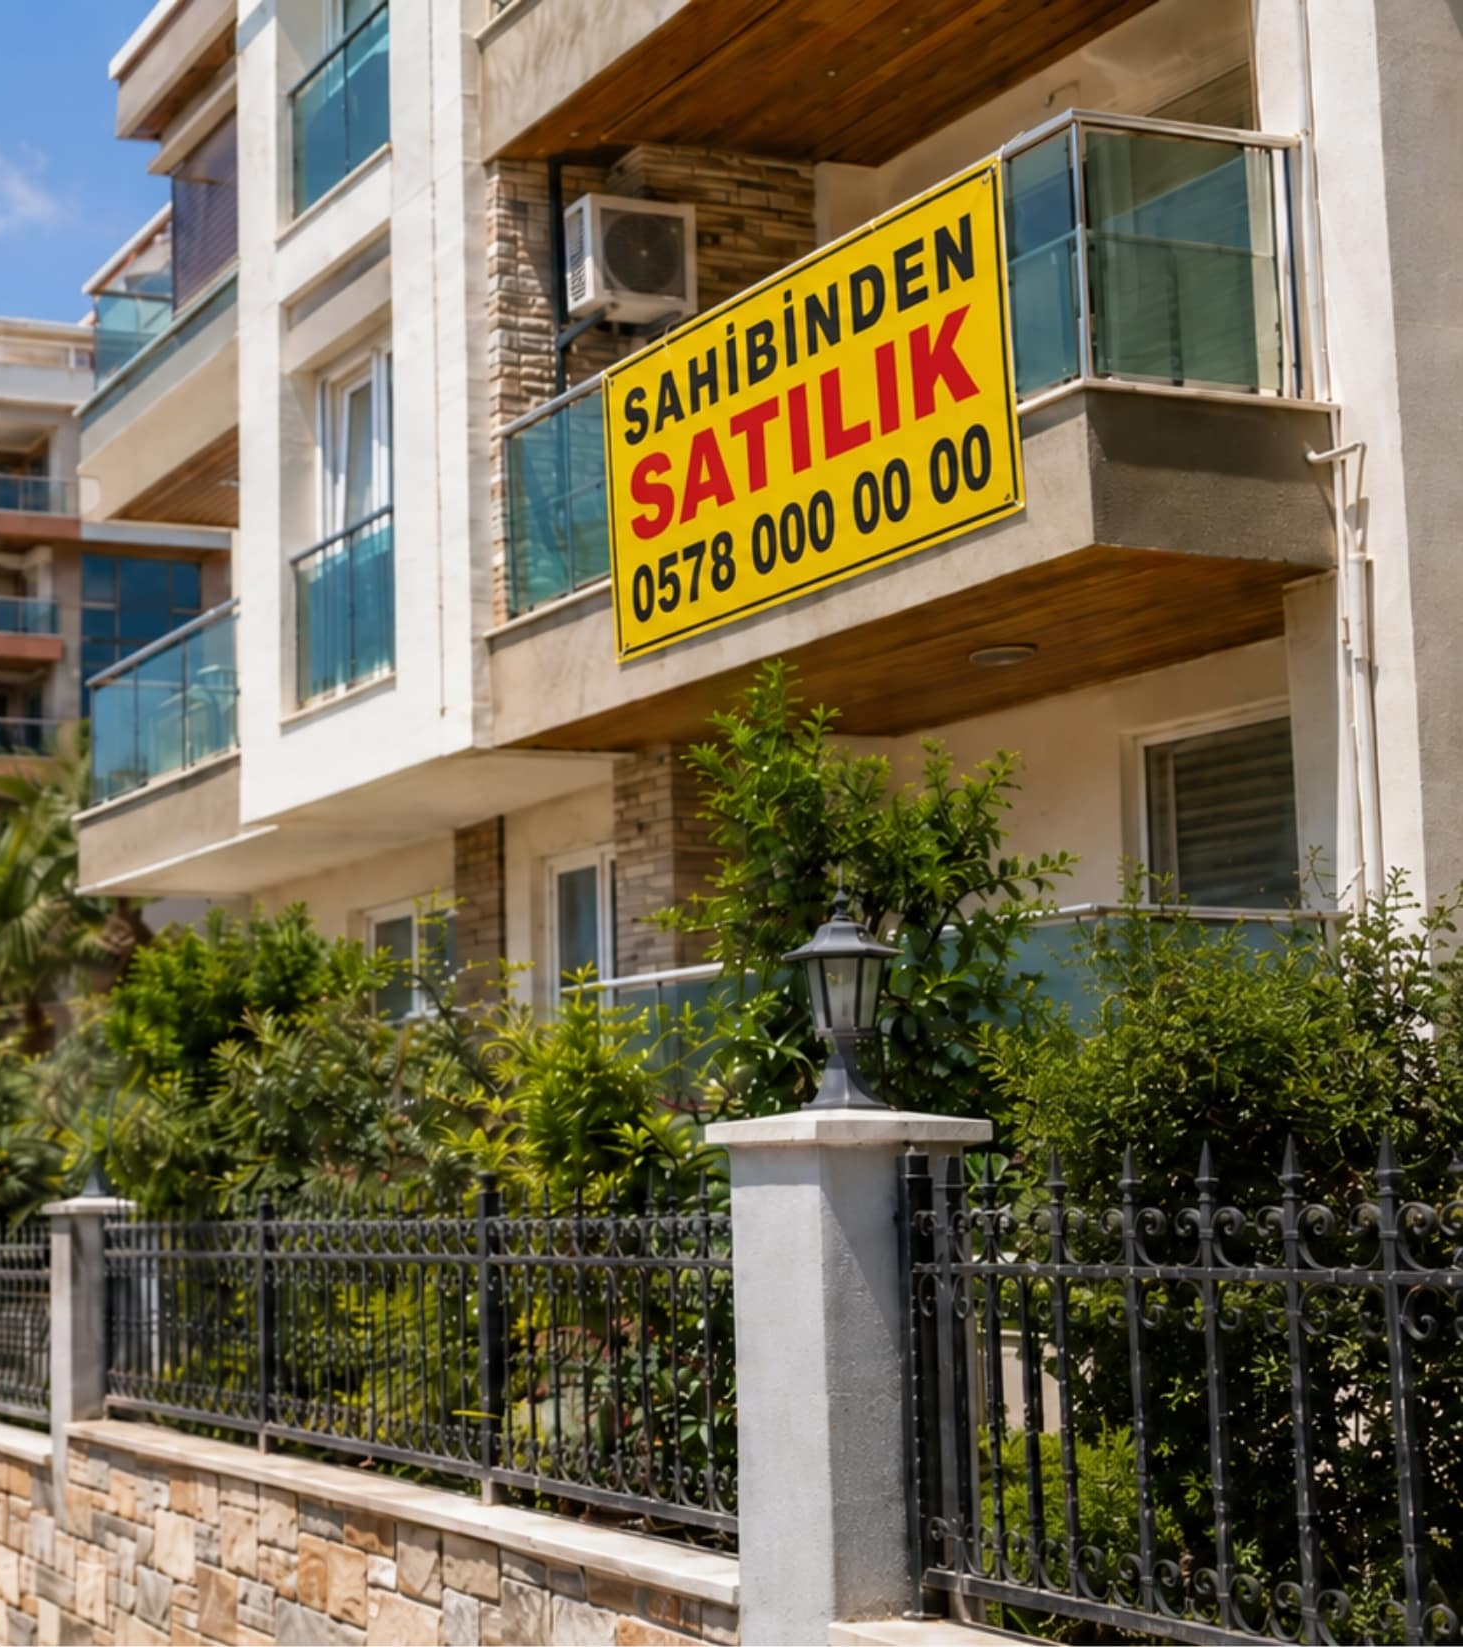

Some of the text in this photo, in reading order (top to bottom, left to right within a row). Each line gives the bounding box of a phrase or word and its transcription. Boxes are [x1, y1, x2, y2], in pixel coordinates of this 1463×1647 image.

[623, 212, 976, 447] SAHİBİNDEN
[629, 303, 980, 541] SATILIK
[632, 423, 992, 623] 0578 000 00 00
